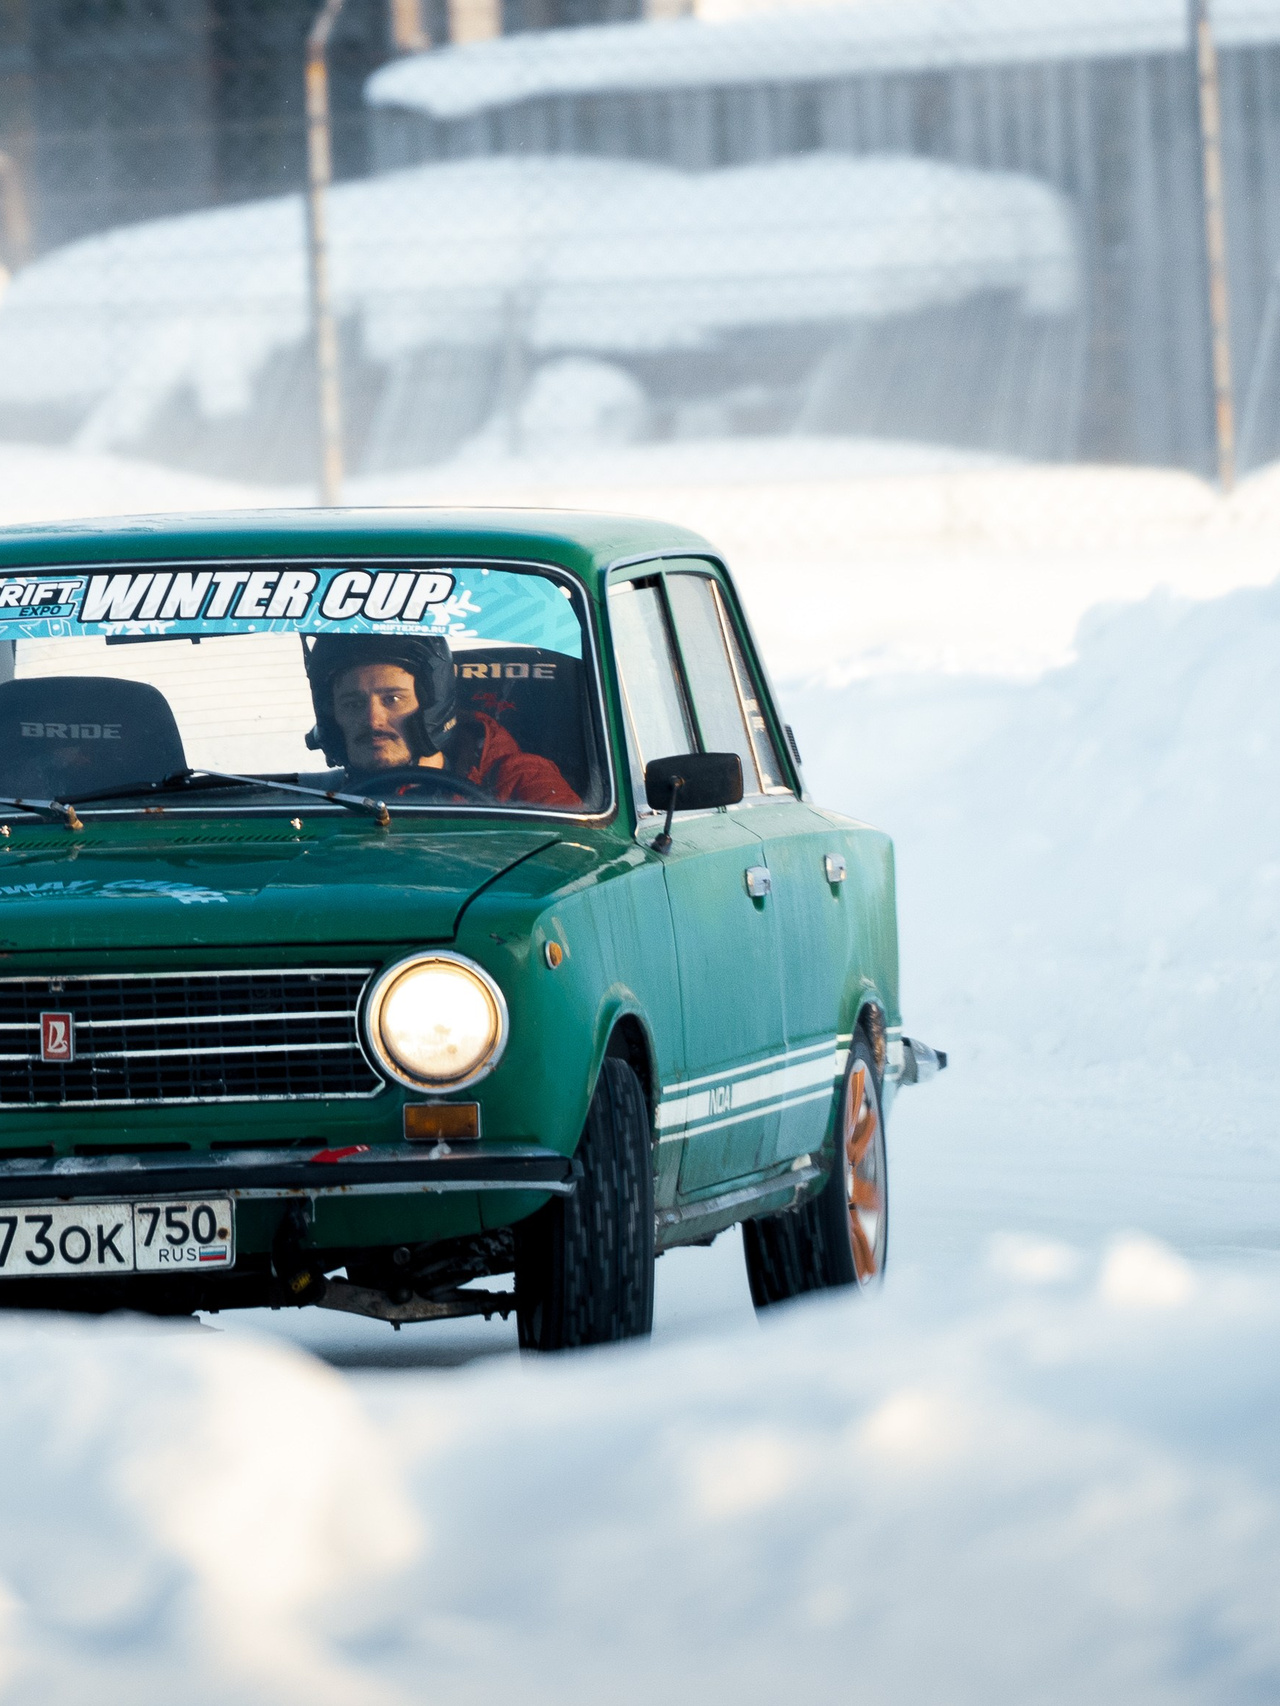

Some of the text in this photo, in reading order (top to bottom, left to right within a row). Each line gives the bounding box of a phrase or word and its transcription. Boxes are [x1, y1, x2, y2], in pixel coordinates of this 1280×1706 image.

[80, 570, 456, 622] WINTER CUP
[19, 606, 62, 617] EXPO
[454, 662, 557, 679] RIDE
[22, 722, 122, 740] BRIDE
[137, 1205, 218, 1247] 750
[158, 1247, 197, 1263] RUS
